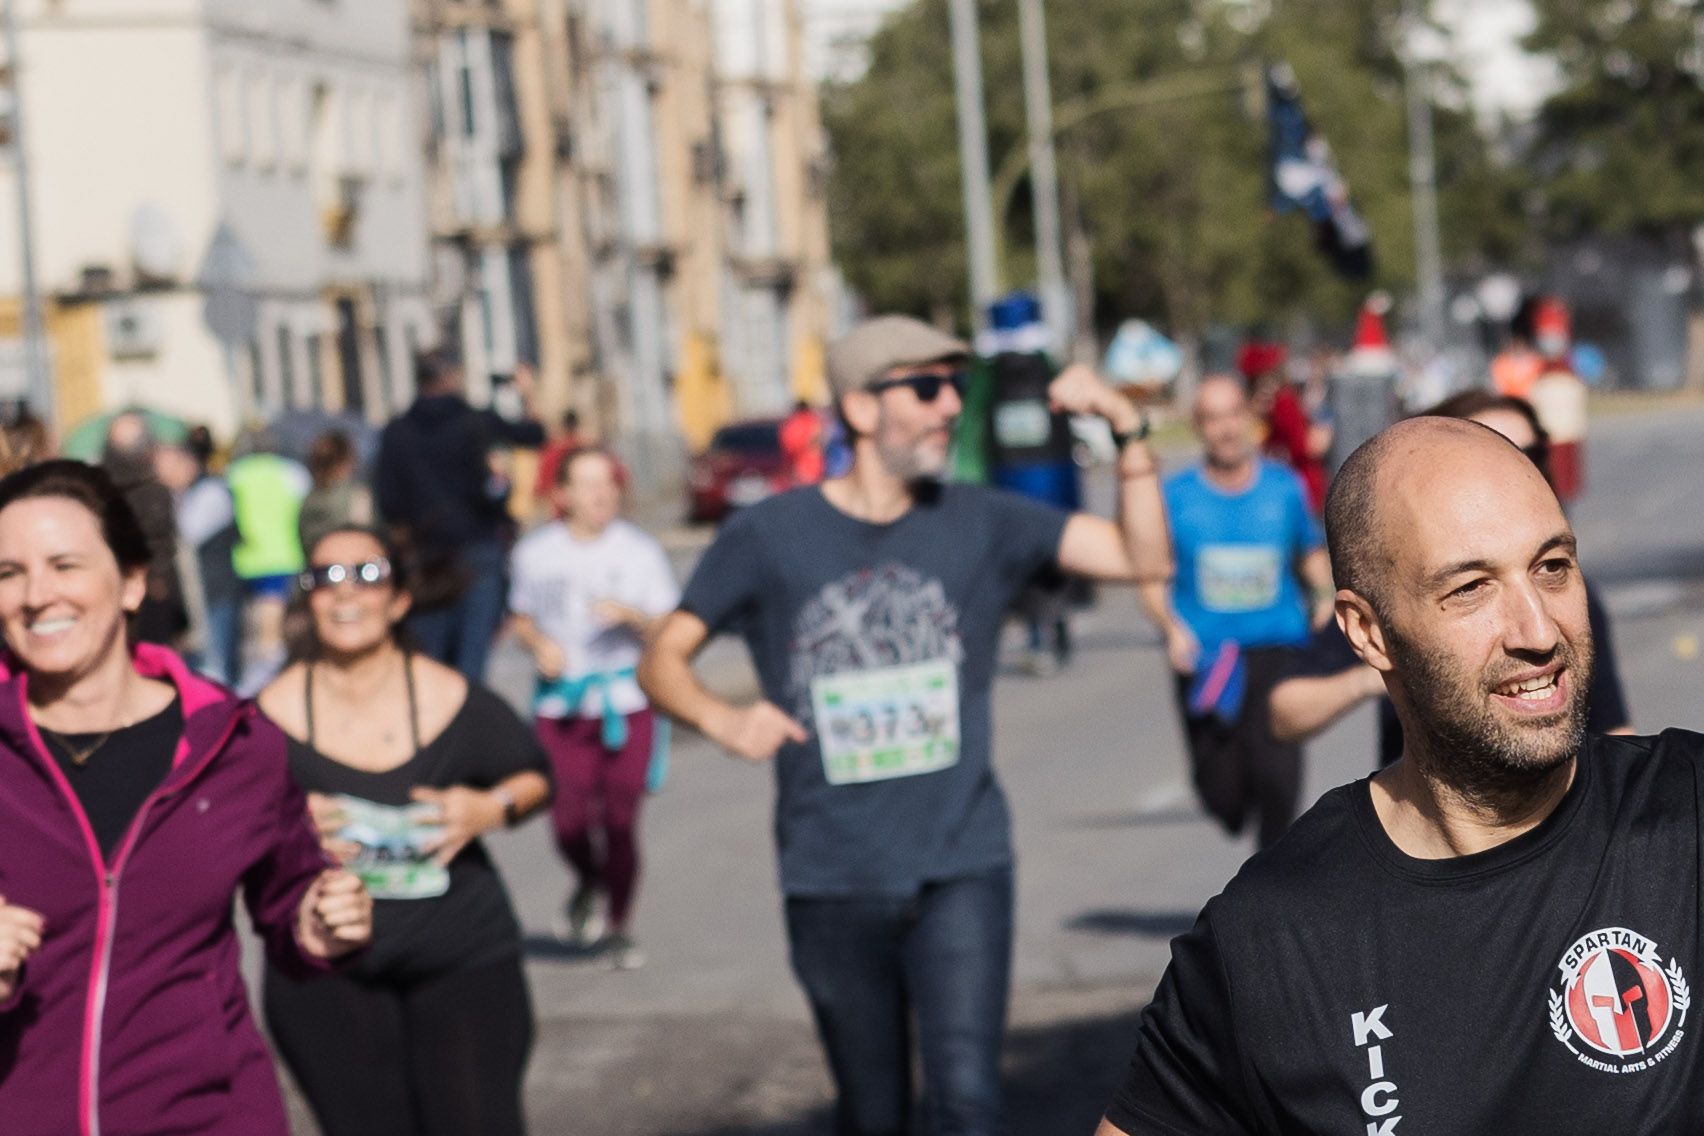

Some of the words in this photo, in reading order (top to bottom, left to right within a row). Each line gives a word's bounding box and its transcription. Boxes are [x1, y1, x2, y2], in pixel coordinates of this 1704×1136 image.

[1565, 931, 1647, 969] SPARTAN
[1577, 1053, 1619, 1073] MARTIAL
[1621, 1062, 1647, 1073] ARTS
[1647, 1057, 1656, 1067] &
[1655, 1030, 1685, 1063] FITNESS
